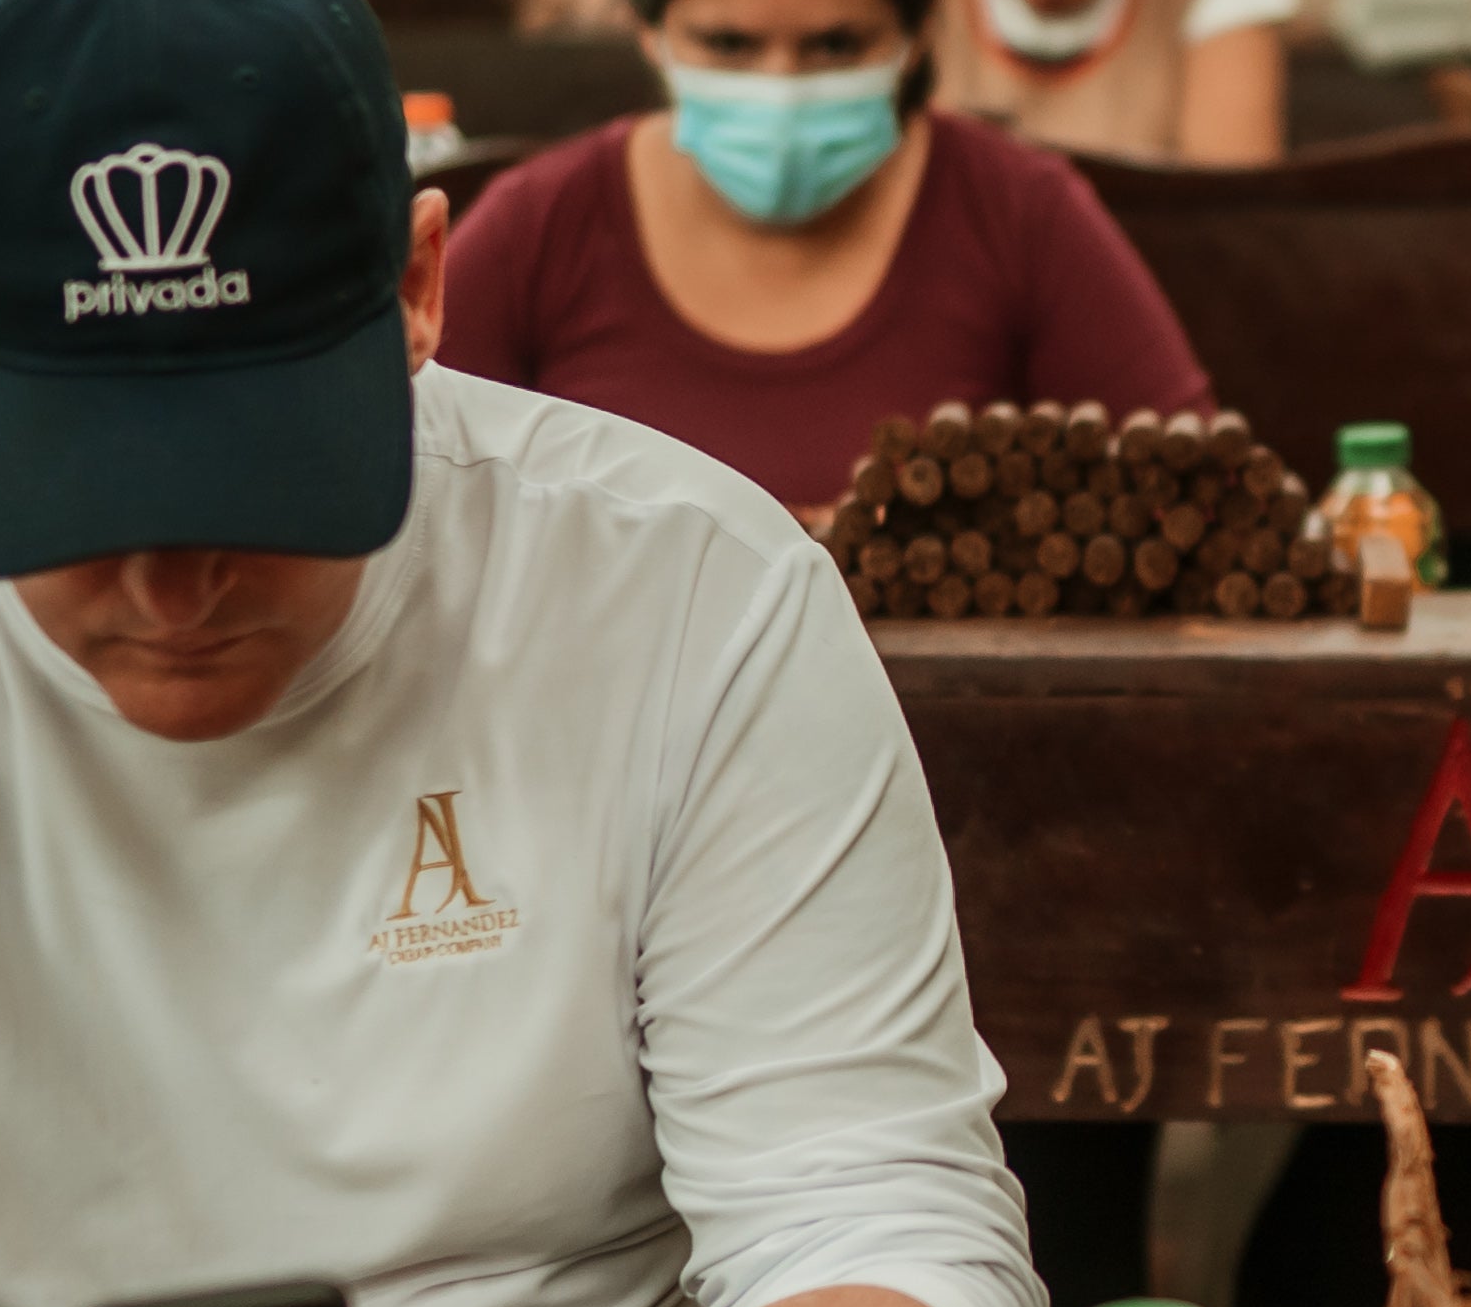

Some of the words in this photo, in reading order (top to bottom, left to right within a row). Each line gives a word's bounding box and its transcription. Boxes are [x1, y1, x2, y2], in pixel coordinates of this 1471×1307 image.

[63, 266, 251, 324] privada
[394, 908, 520, 948] FERNANDEZ
[1051, 1014, 1169, 1113] AJ
